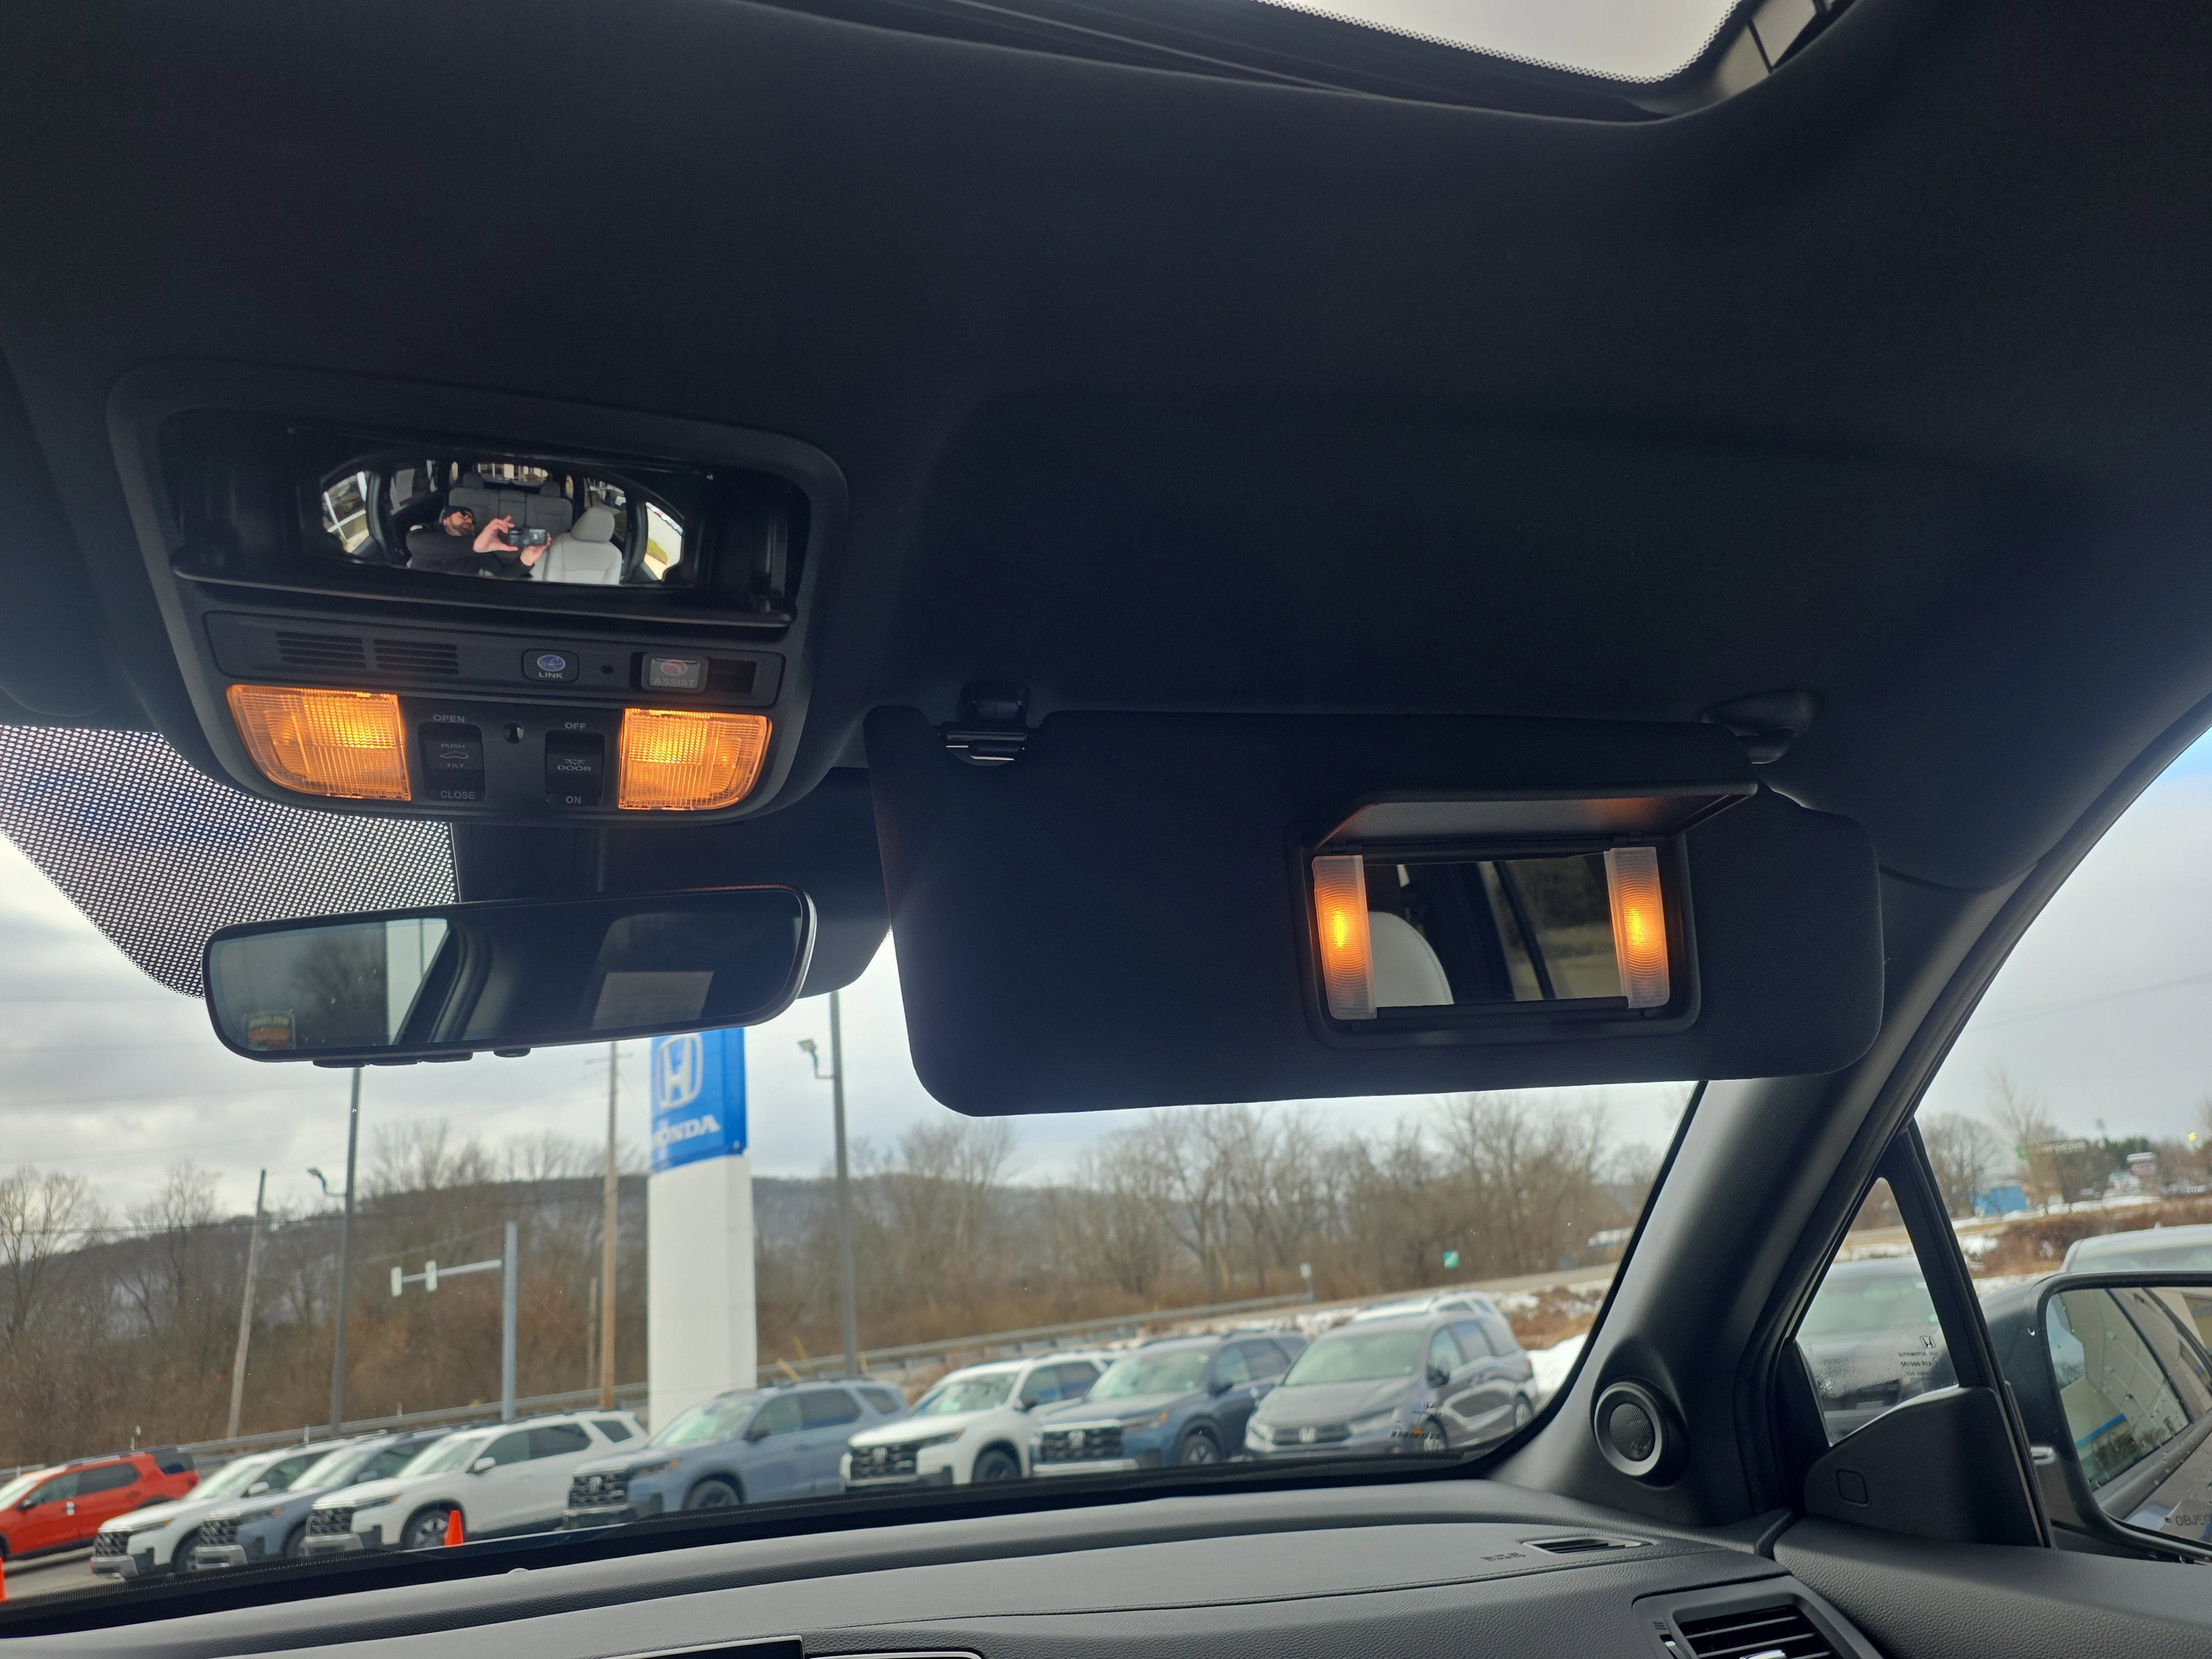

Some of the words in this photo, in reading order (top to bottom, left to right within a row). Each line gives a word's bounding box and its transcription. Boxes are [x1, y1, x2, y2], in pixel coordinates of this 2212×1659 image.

[654, 677, 695, 686] ASSIST
[433, 714, 466, 723] OPEN
[441, 790, 475, 800] CLOSE
[566, 796, 582, 804] ON
